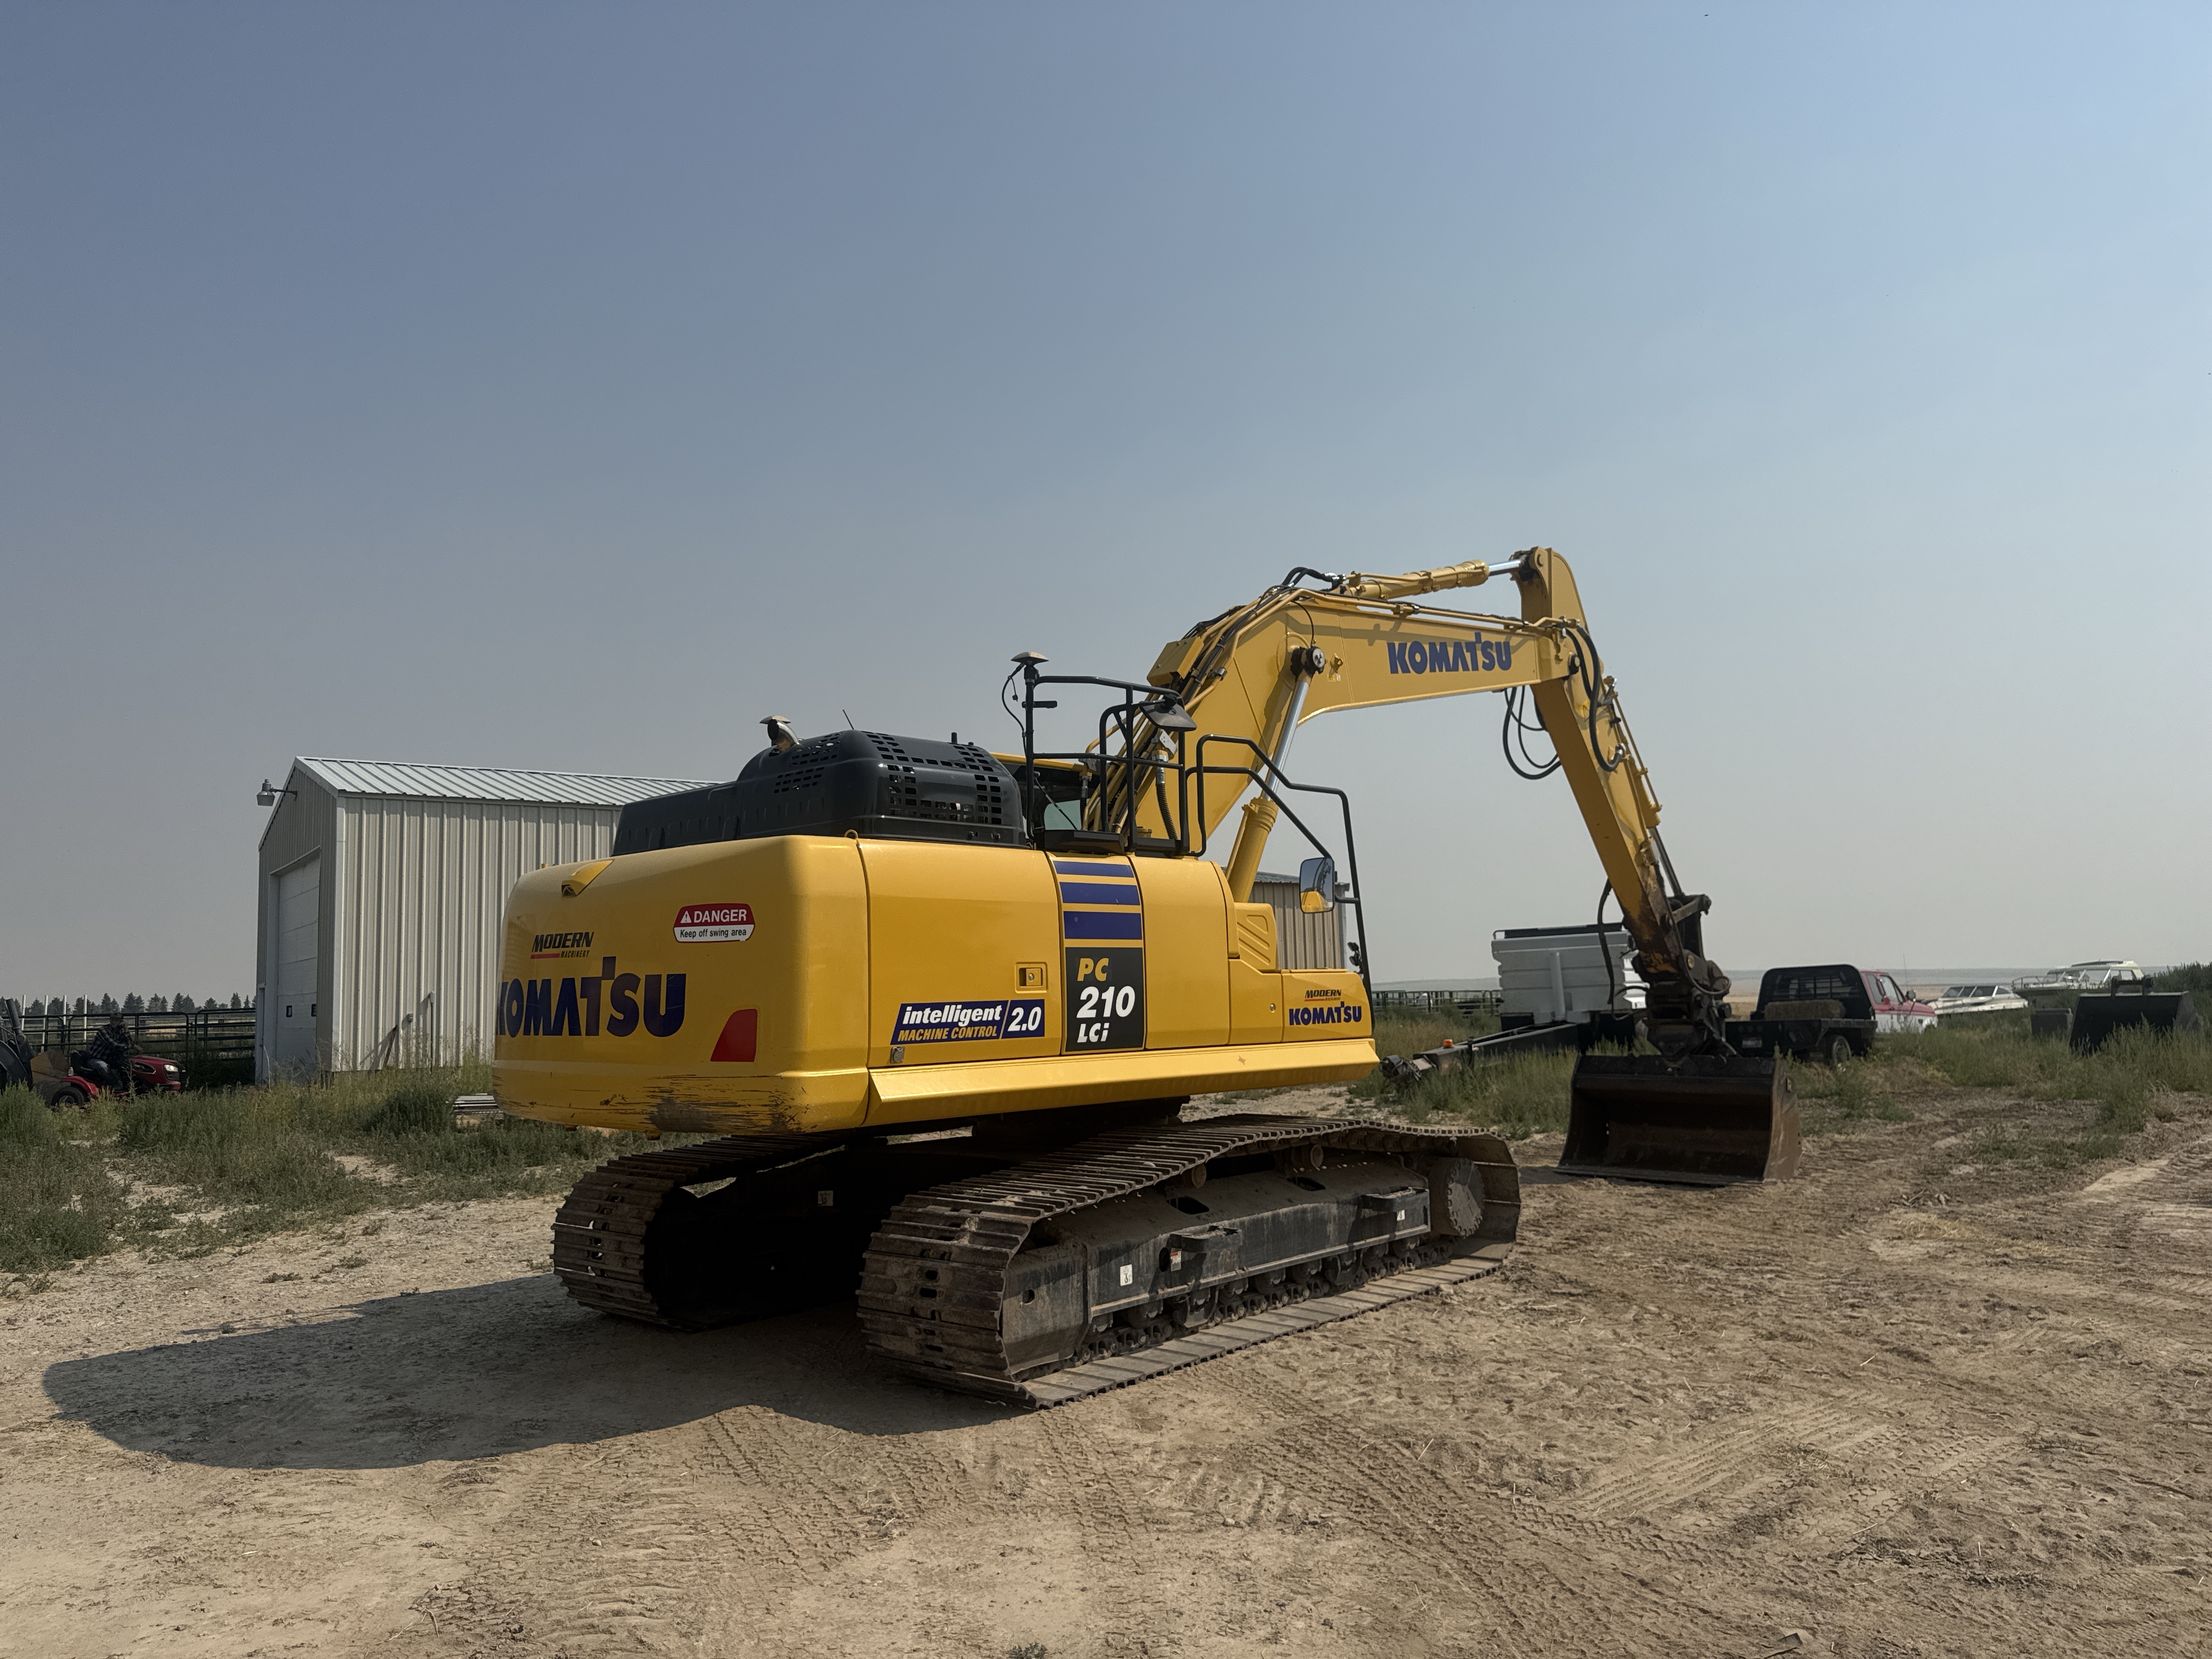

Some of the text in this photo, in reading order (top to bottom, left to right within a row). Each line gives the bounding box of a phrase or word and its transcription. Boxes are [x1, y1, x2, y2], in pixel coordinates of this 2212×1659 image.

[1387, 632, 1512, 674] KOMATSU
[693, 909, 747, 923] DANGER
[532, 932, 594, 952] MODERN
[680, 929, 696, 939] Keep
[699, 929, 708, 937] off
[710, 928, 729, 938] swing
[1077, 957, 1109, 981] PC
[1076, 986, 1136, 1018] 210
[1305, 989, 1342, 998] MODERN
[902, 1005, 1042, 1031] intelligent 2.0
[1289, 1001, 1362, 1025] KOMATSU
[897, 1025, 997, 1041] MACHINE CONTROL
[1077, 1023, 1109, 1043] LCi
